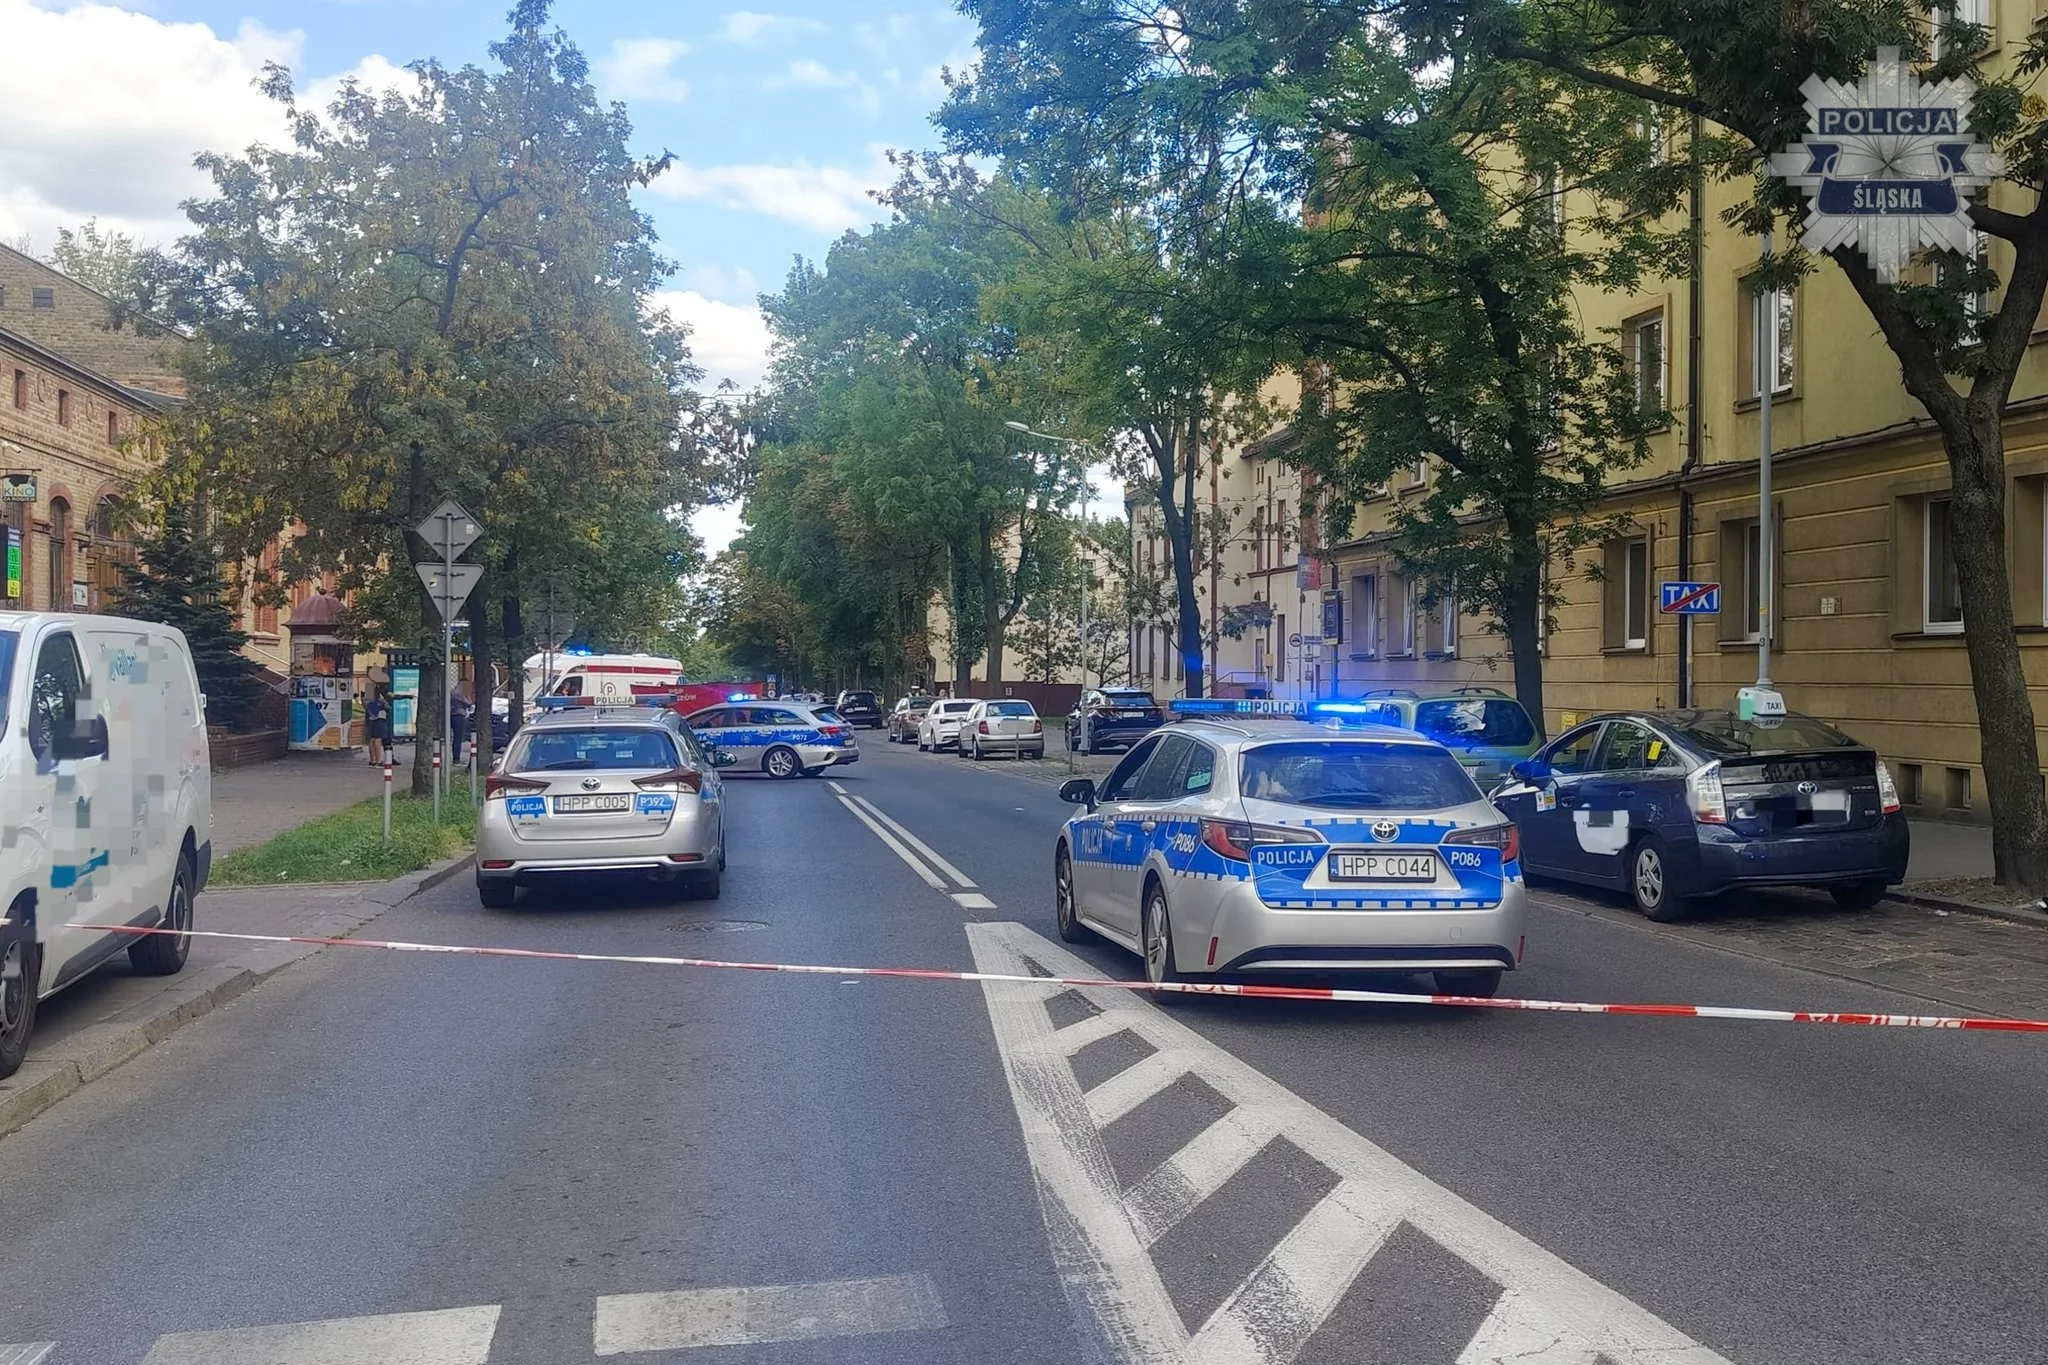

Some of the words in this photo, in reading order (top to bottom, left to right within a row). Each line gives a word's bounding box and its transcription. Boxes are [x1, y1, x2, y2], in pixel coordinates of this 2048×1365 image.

[4, 487, 34, 496] KINO
[1665, 586, 1718, 610] TAXI
[596, 696, 634, 704] POLICJA
[1766, 702, 1782, 710] TAXI
[1256, 701, 1306, 715] POLICJA
[511, 803, 544, 812] POLICJA
[562, 796, 591, 811] HPP
[595, 794, 627, 809] C005
[1173, 832, 1196, 853] P086
[1257, 850, 1315, 865] POLICJA
[1451, 851, 1482, 867] P086
[1343, 857, 1378, 876] HPP
[1385, 858, 1431, 877] C044
